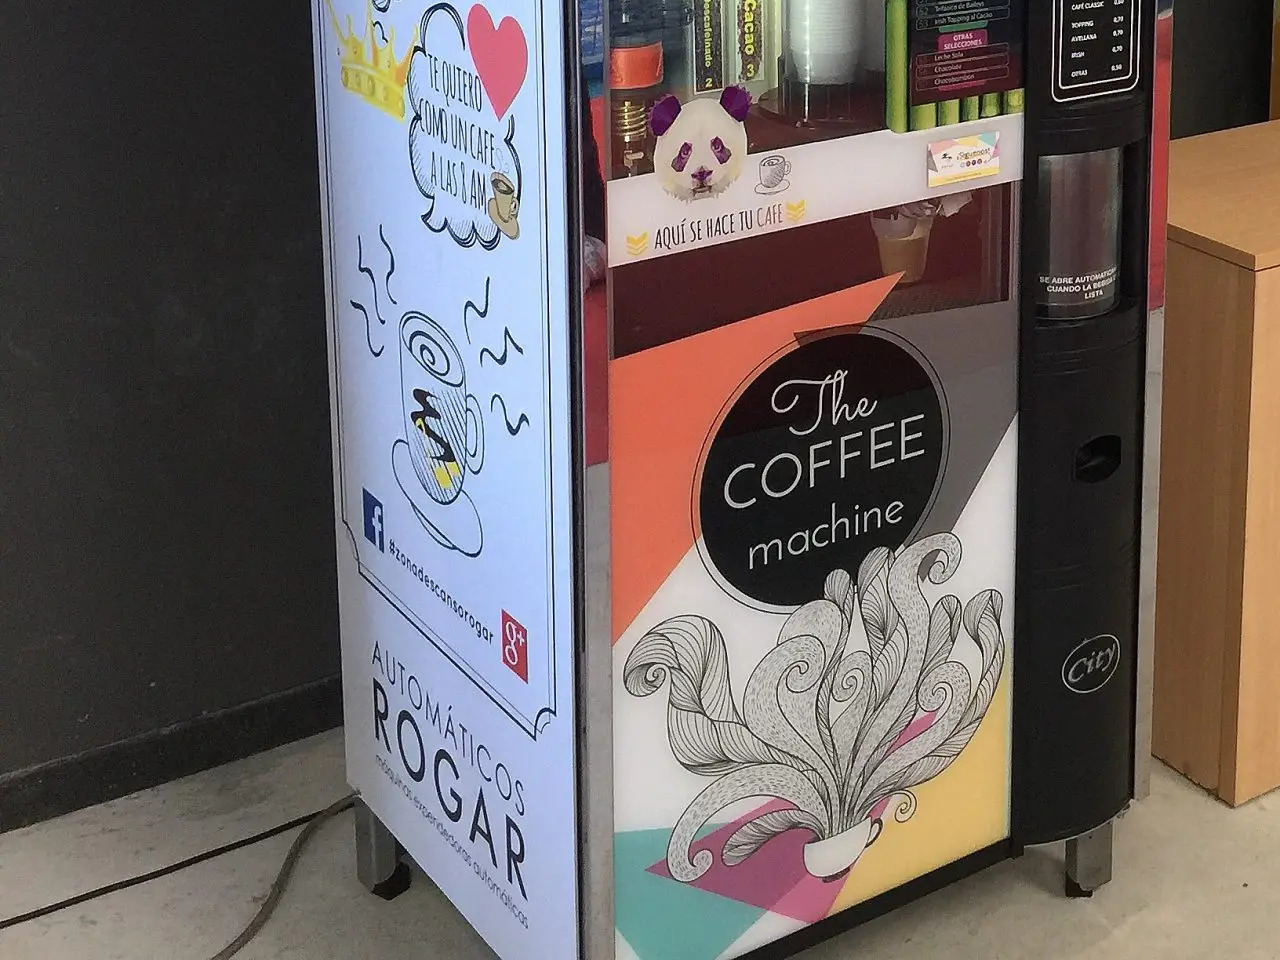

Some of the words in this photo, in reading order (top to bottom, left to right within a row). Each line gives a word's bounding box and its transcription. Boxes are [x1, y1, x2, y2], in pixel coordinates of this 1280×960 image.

[428, 54, 439, 91] TE
[442, 61, 482, 112] QUIERO
[705, 77, 713, 88] 2
[746, 64, 755, 77] 3
[419, 98, 448, 144] COMO
[450, 117, 467, 154] UN
[470, 123, 496, 170] CAFE
[430, 152, 437, 187] A
[440, 156, 457, 197] LAS
[460, 161, 467, 204] 8
[471, 169, 487, 215] AM
[654, 217, 687, 250] AQUÍ
[689, 219, 703, 241] SE
[706, 212, 735, 237] HACE
[738, 209, 753, 232] TU
[756, 203, 783, 229] CAFE
[1051, 276, 1073, 284] ABRE
[1083, 283, 1092, 291] LA
[771, 369, 878, 436] The
[724, 414, 925, 509] COFFEE
[749, 500, 904, 569] machine
[388, 538, 494, 644] #zonadescansorogar
[372, 640, 525, 816] AUTOMÁTICOS
[373, 677, 528, 901] ROGAR
